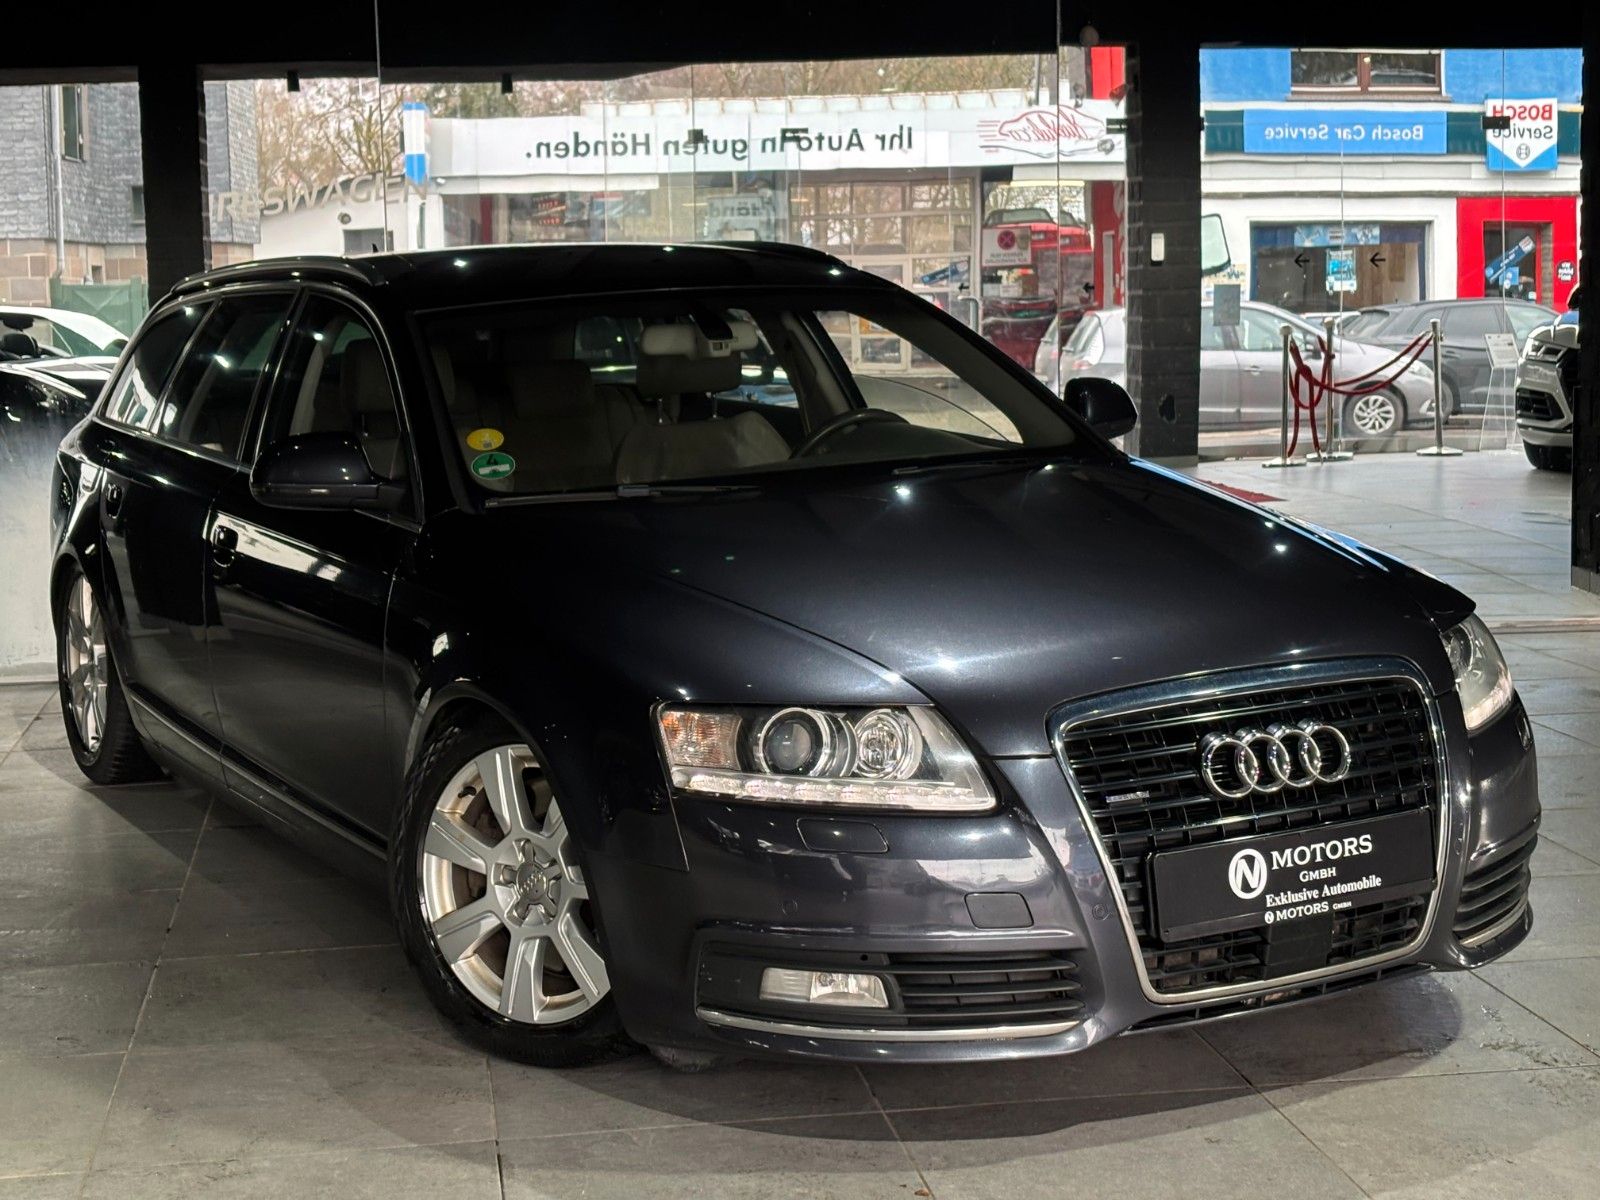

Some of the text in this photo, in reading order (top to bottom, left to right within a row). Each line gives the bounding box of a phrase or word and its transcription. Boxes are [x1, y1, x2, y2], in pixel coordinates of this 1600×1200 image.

[1270, 834, 1373, 870] MOTORS
[1299, 867, 1337, 883] GMBH
[1265, 874, 1382, 908] Exklusive Automobile
[1276, 901, 1329, 922] MOTORS
[1332, 900, 1352, 911] GMBH
